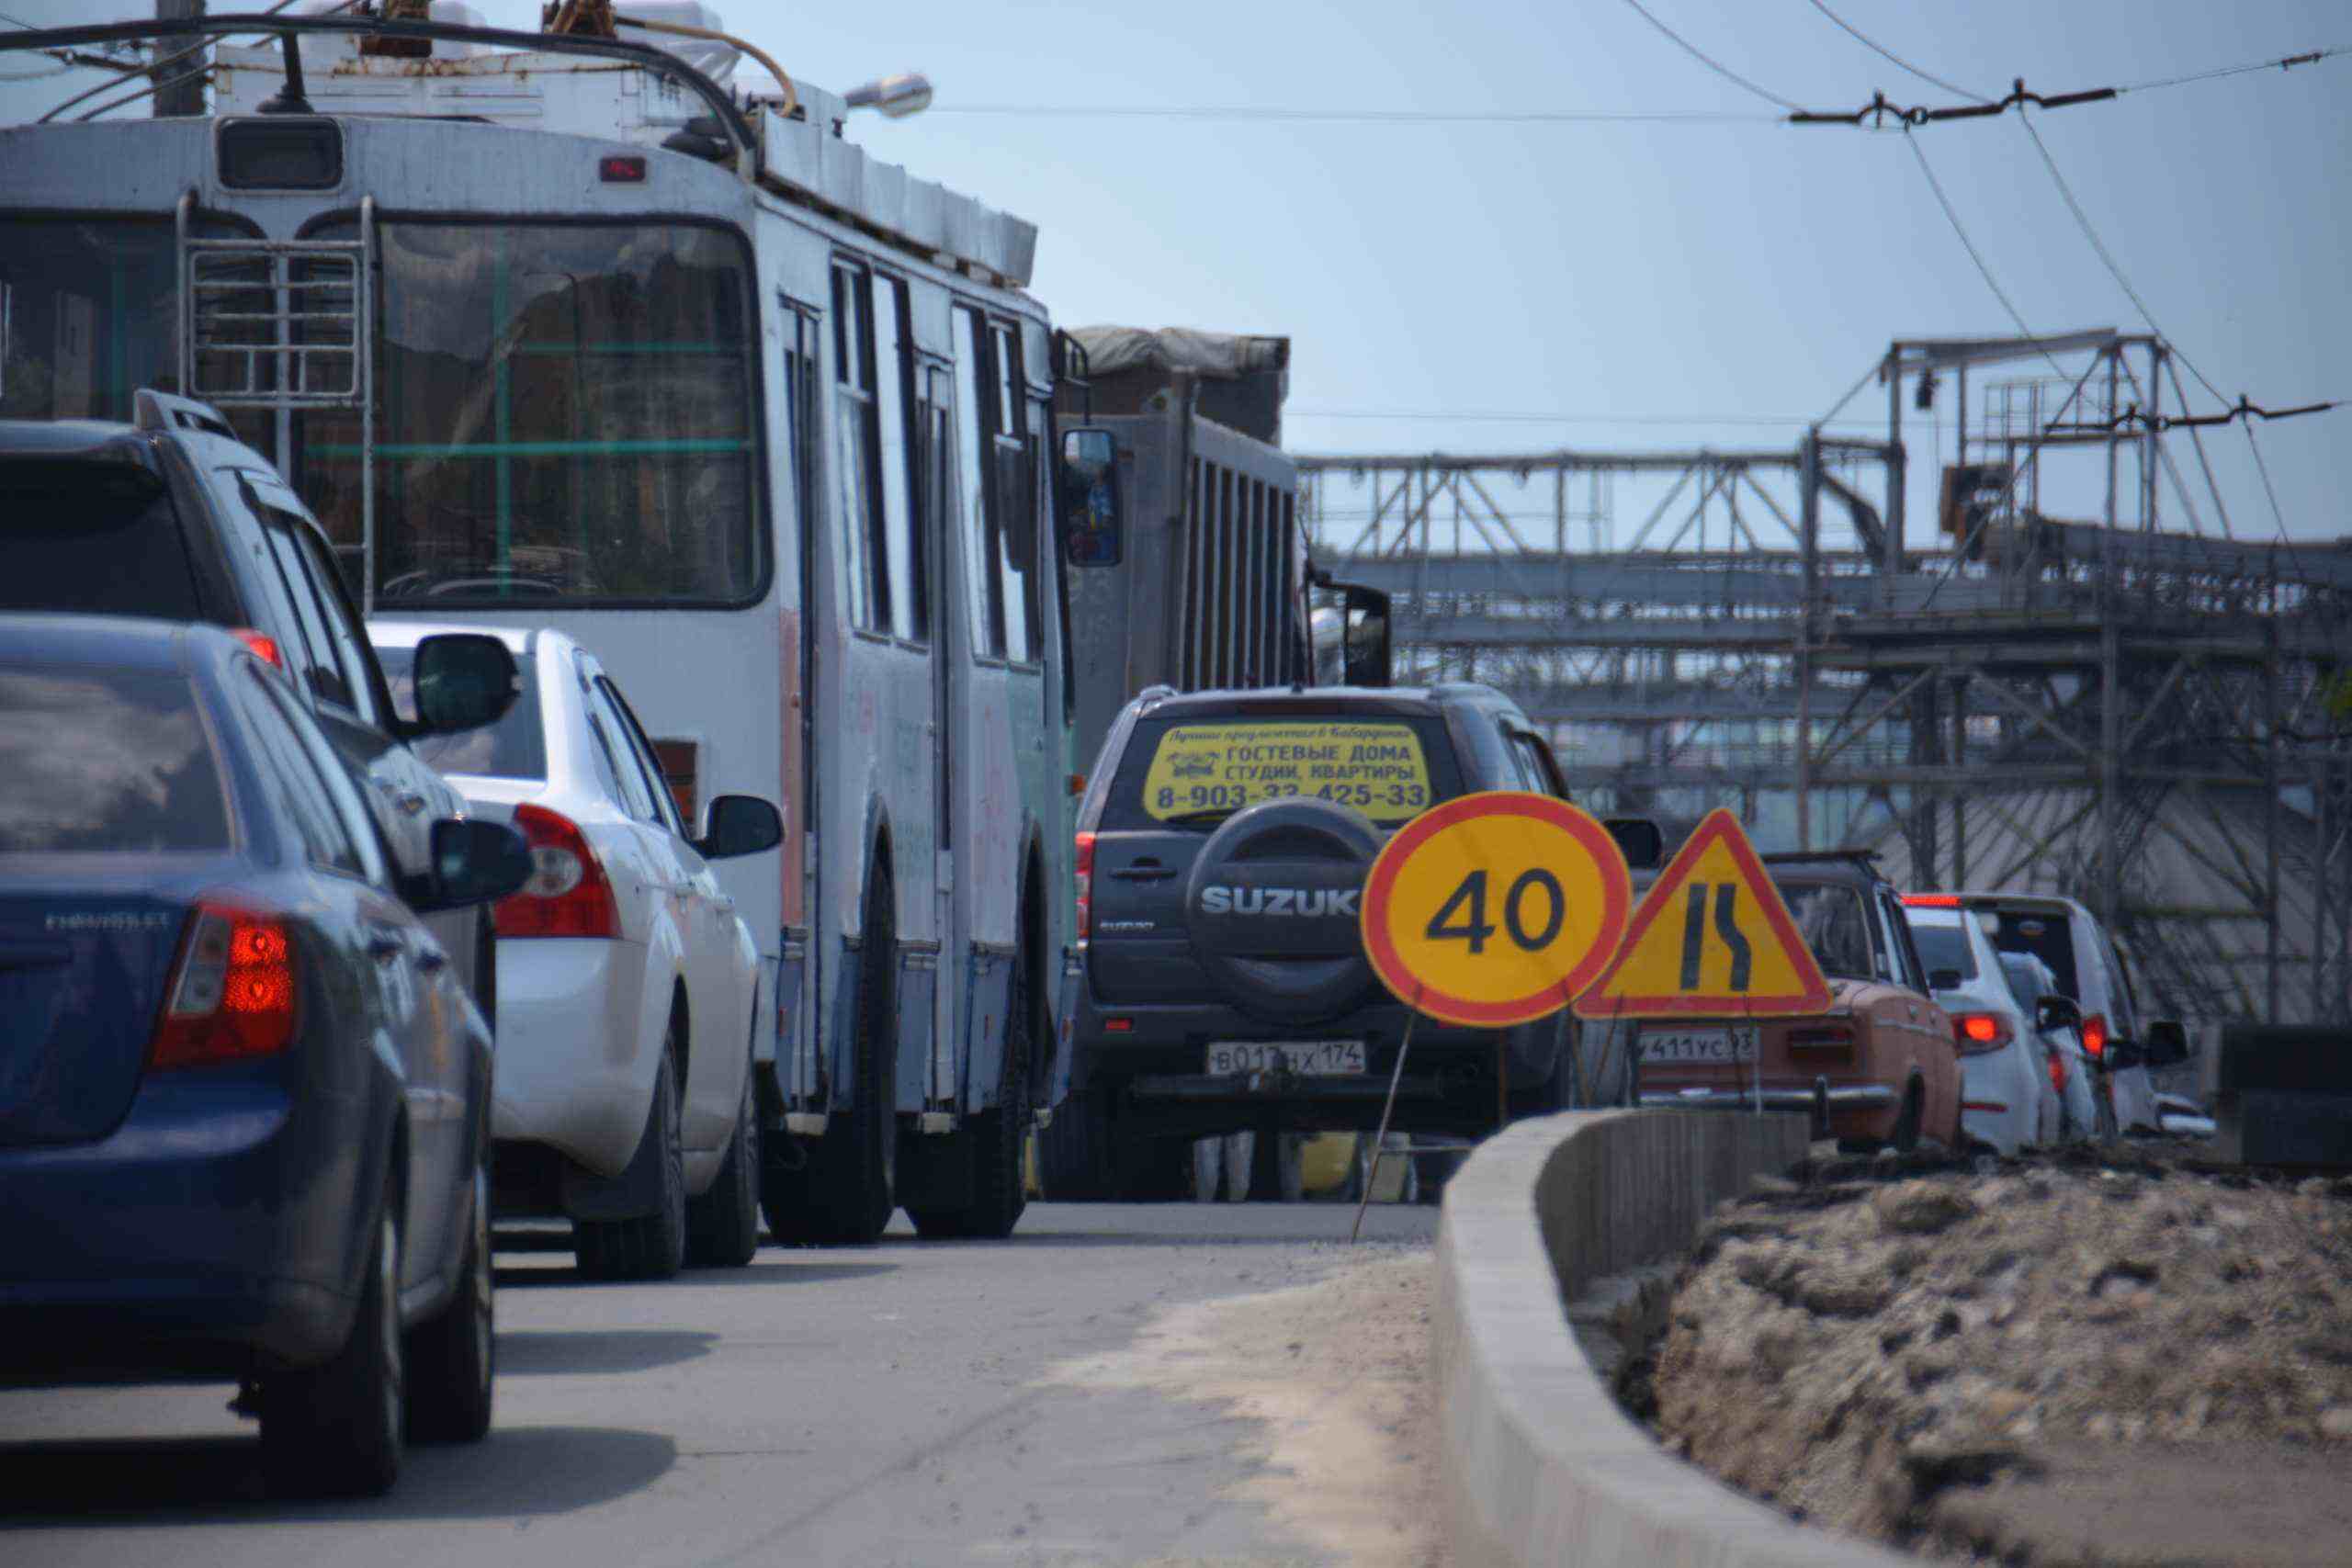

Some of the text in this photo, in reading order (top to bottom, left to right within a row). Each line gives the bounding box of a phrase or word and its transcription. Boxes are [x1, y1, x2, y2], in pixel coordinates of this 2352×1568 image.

[1227, 745, 1411, 762] ГОСТЕВЫЕ ДОМА
[1225, 765, 1416, 781] СТУДИИ, КВАРТИРЫ
[1200, 886, 1360, 917] SUZUK
[1425, 867, 1565, 954] 40
